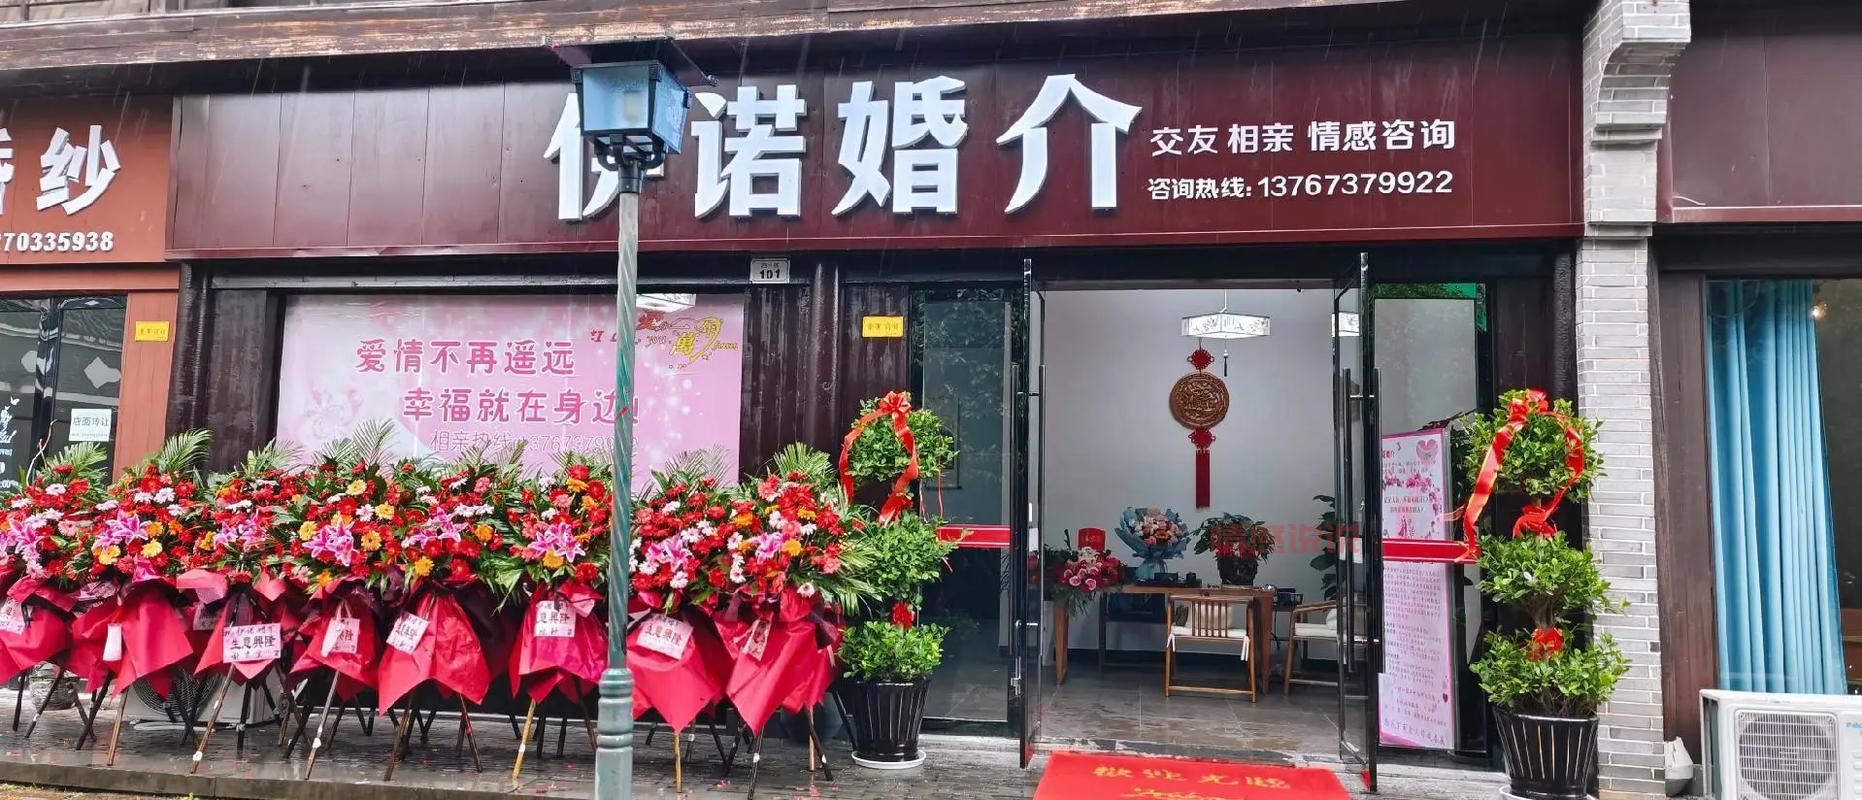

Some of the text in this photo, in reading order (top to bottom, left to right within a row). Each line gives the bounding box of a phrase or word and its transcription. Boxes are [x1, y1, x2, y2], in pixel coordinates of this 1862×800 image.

[1150, 118, 1456, 157] 交友 相亲 情感咨询
[0, 124, 122, 216] 纱
[1147, 170, 1454, 200] 咨询热线: 13767379922
[0, 231, 114, 252] 70335938
[759, 268, 781, 280] 101
[353, 337, 577, 377] 爱情不再遥远
